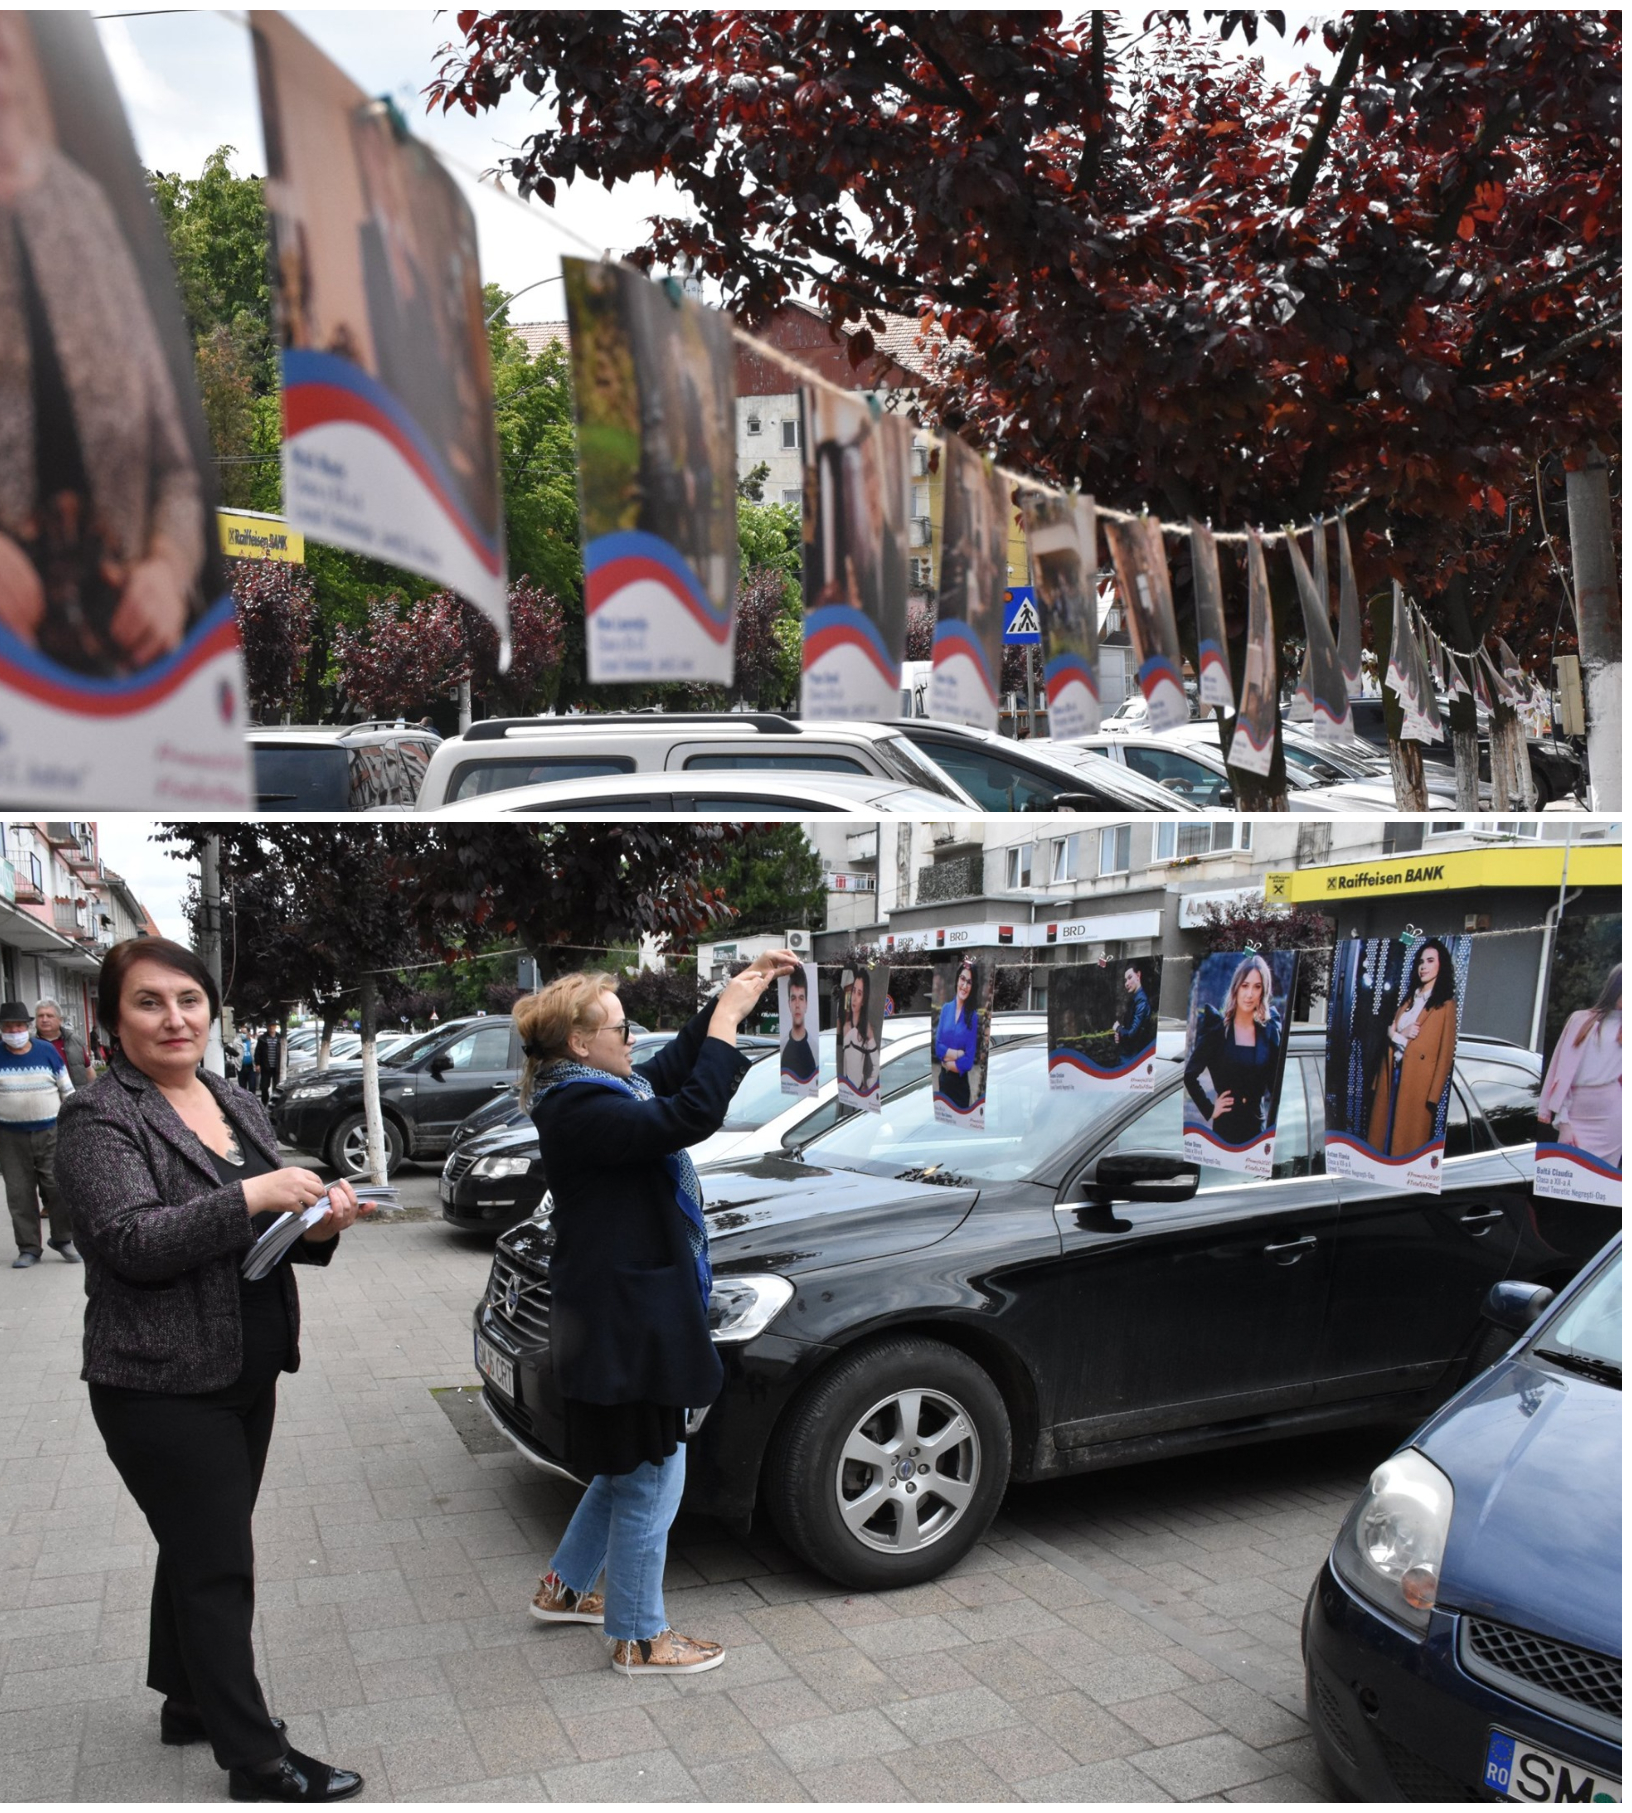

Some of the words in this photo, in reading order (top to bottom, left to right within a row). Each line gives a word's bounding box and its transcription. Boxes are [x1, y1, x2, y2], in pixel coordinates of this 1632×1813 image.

[234, 528, 268, 547] Raiffeisen
[1339, 871, 1402, 889] Raiffeisen
[1404, 865, 1445, 883] BANK
[950, 931, 968, 942] BRD
[1063, 925, 1086, 937] BRD
[1552, 1168, 1573, 1178] Claudia
[1536, 1175, 1548, 1183] Clasa
[1554, 1178, 1566, 1187] XII-a
[1536, 1184, 1548, 1193] Liceul
[1551, 1185, 1570, 1195] Teoretic
[496, 1356, 512, 1394] CRT
[1486, 1761, 1509, 1786] RO
[1516, 1753, 1595, 1803] SM
